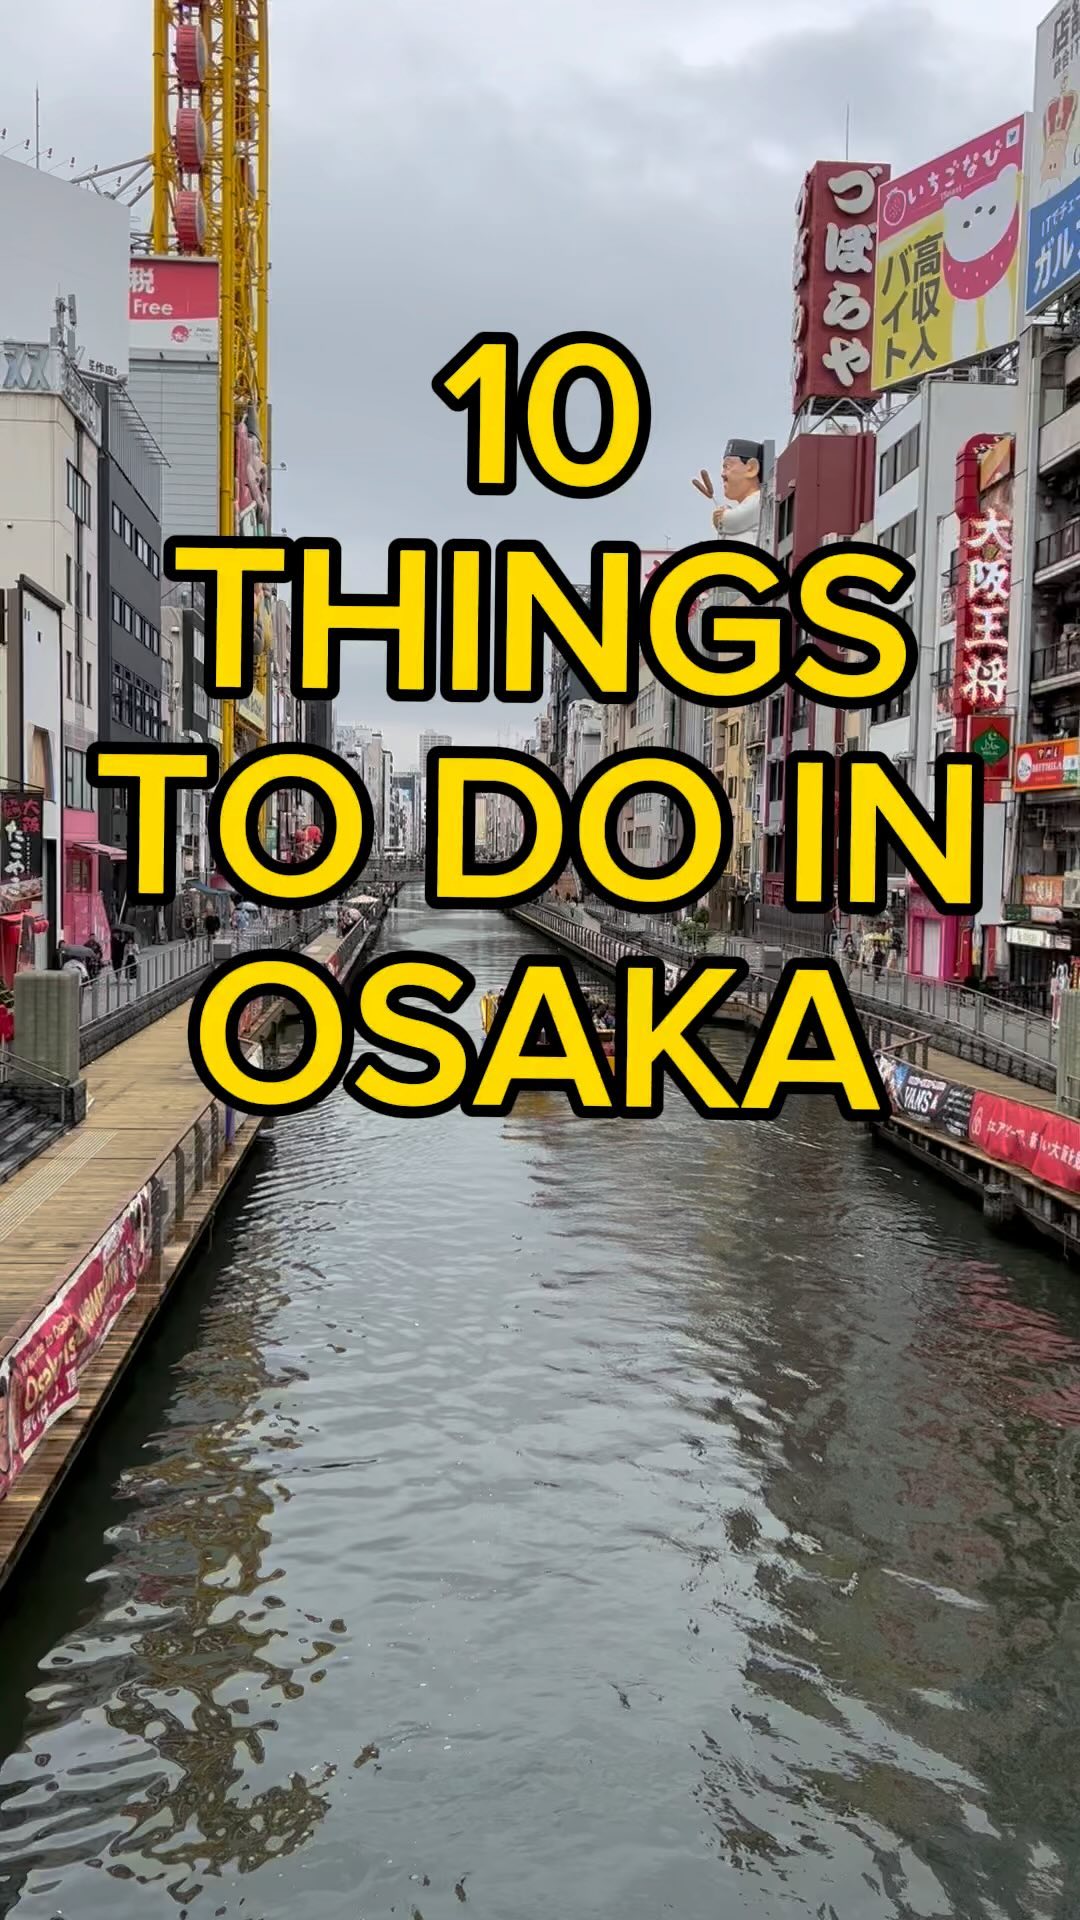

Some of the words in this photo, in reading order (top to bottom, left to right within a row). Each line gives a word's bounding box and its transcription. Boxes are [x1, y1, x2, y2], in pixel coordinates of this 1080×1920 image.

[907, 139, 1003, 205] いちごなび
[133, 298, 174, 316] Free
[822, 166, 884, 388] づぼらや
[910, 231, 943, 369] 高収入
[1033, 218, 1080, 295] ガル
[880, 246, 916, 379] バイト
[961, 508, 1013, 706] 大阪王将
[903, 1085, 933, 1114] VANS
